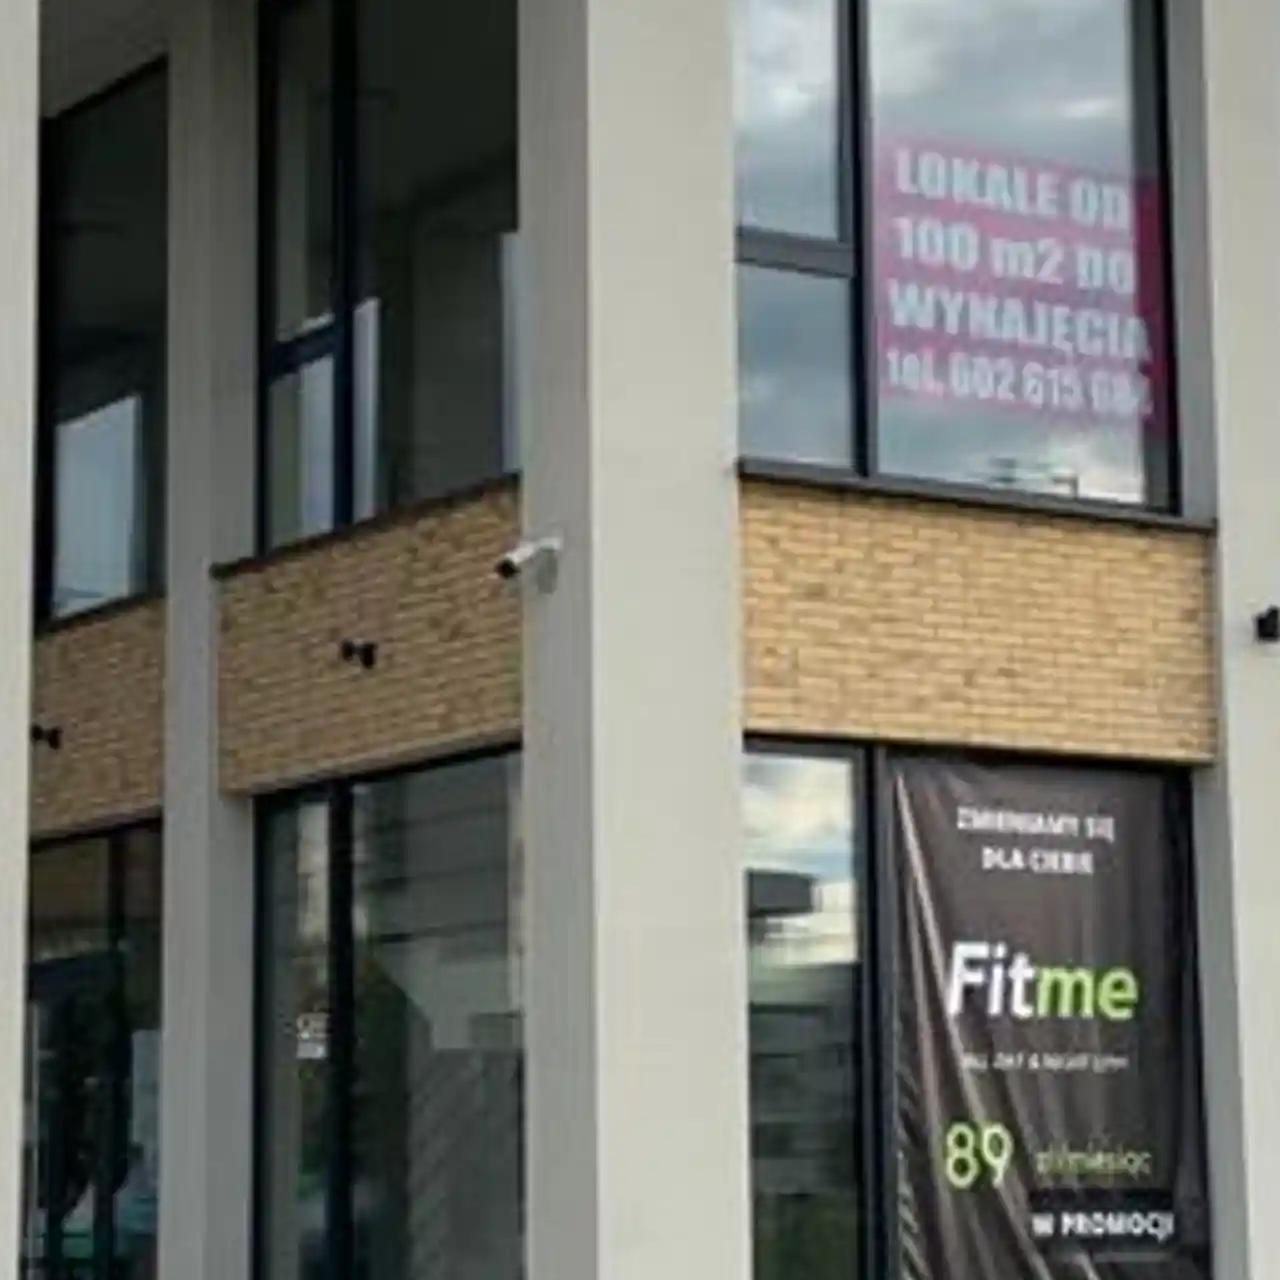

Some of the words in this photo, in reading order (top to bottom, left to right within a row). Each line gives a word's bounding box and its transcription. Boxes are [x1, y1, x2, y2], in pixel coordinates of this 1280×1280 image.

[894, 150, 1060, 216] LOKALE
[894, 217, 981, 271] 100
[990, 236, 1066, 286] m2
[948, 941, 1140, 1020] Fitme
[946, 1123, 1013, 1189] 89
